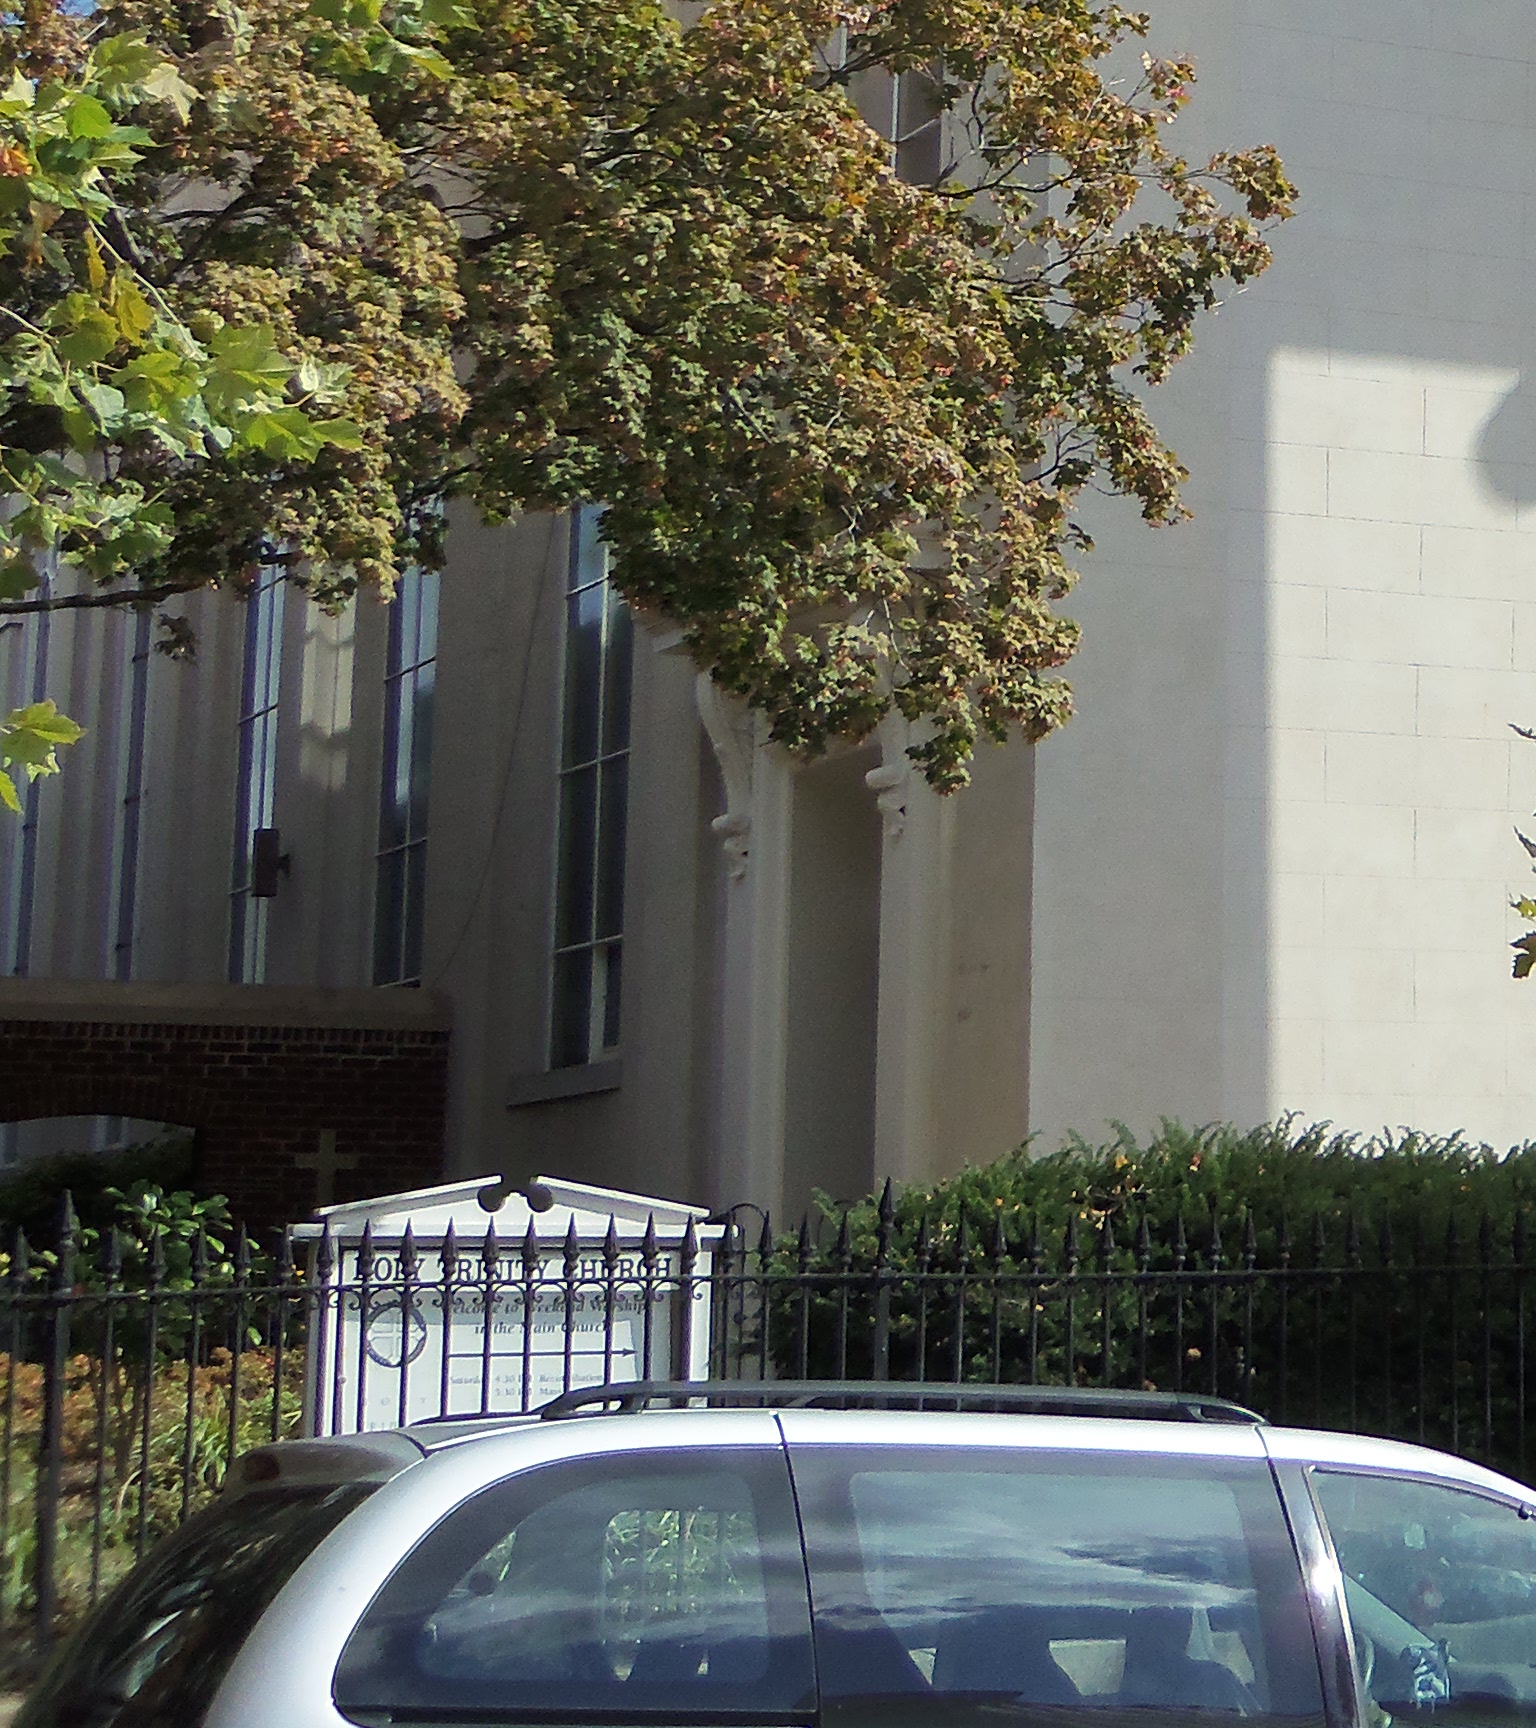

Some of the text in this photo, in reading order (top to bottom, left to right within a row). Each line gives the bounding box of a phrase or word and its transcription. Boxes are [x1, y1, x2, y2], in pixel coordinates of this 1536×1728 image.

[437, 1258, 549, 1281] RINITY
[443, 1301, 500, 1313] elcoe
[505, 1302, 518, 1313] to
[590, 1299, 645, 1314] Wship
[494, 1322, 514, 1334] the
[520, 1322, 556, 1334] ain
